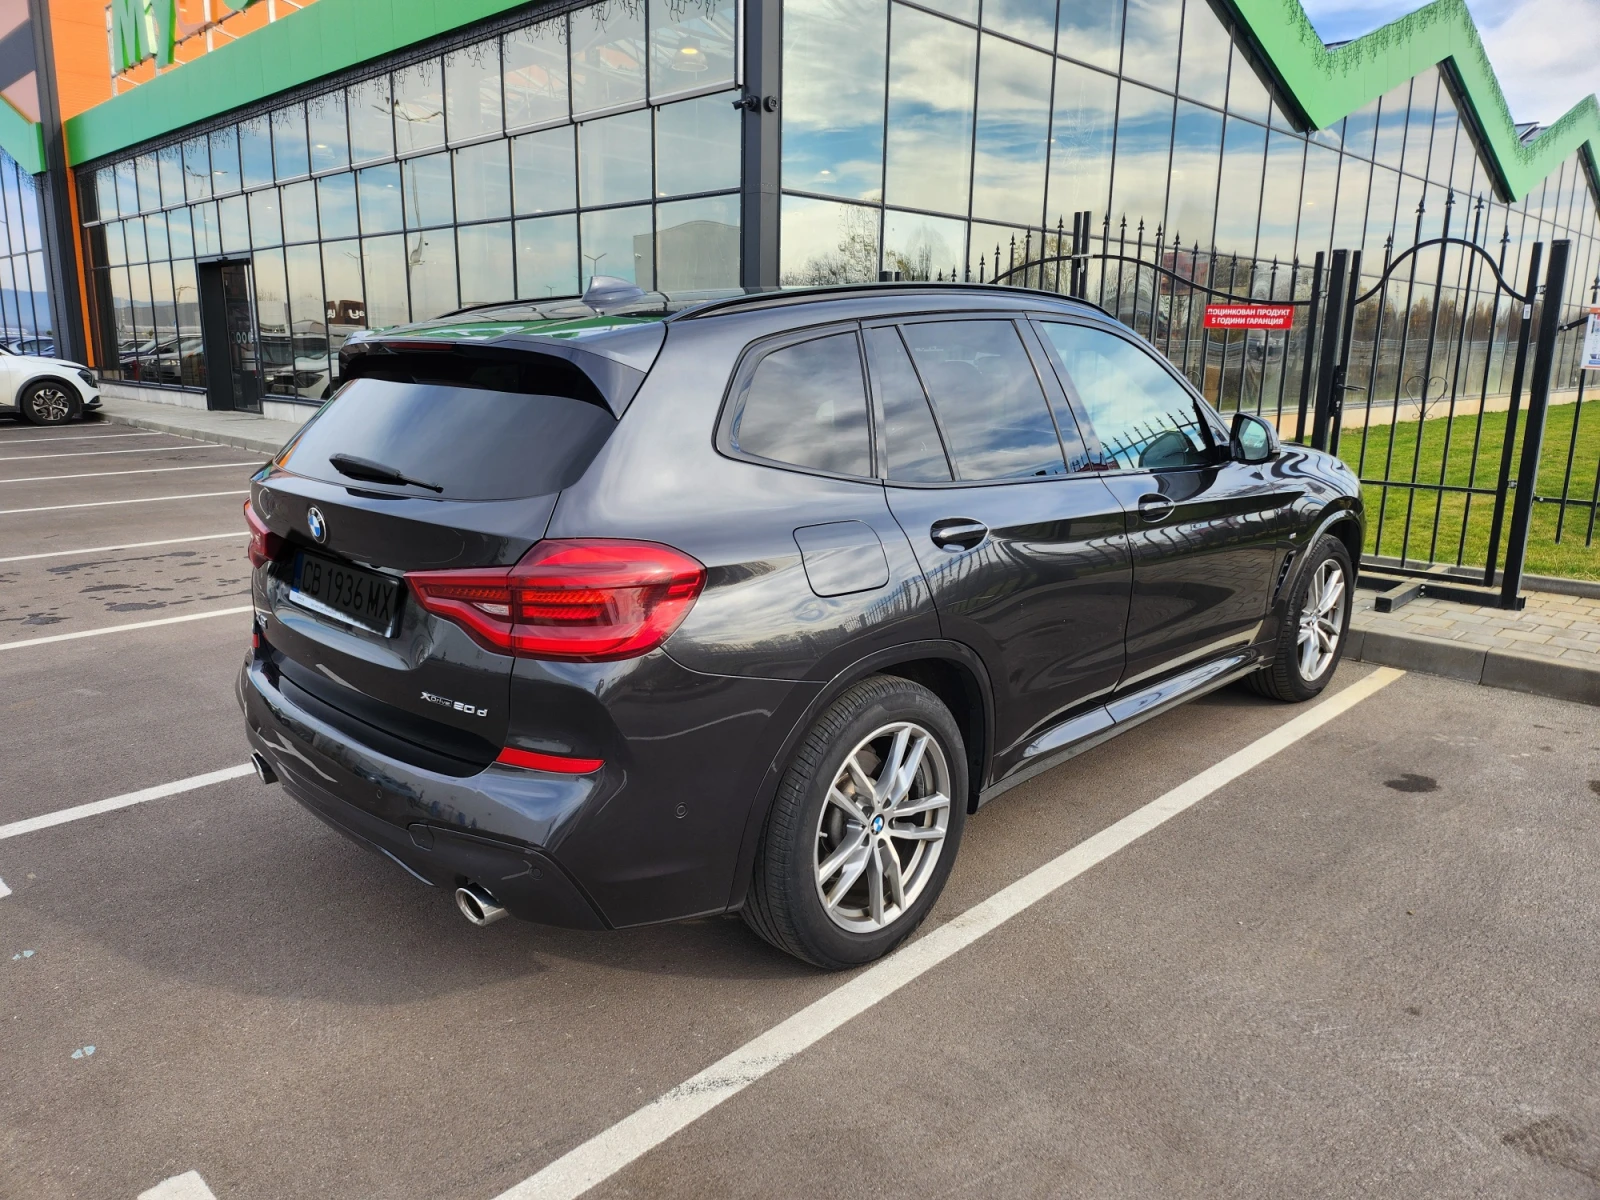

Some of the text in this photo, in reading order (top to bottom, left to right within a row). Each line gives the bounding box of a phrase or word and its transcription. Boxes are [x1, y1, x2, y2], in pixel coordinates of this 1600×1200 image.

[1207, 308, 1291, 316] ПОЦИНКОВАН ПРОДУКТ
[1216, 317, 1246, 325] ГОДИНИ
[1246, 317, 1284, 326] ГАРАНЦИЯ
[302, 560, 322, 596] CB
[326, 567, 364, 611] 1936
[366, 580, 394, 621] MX
